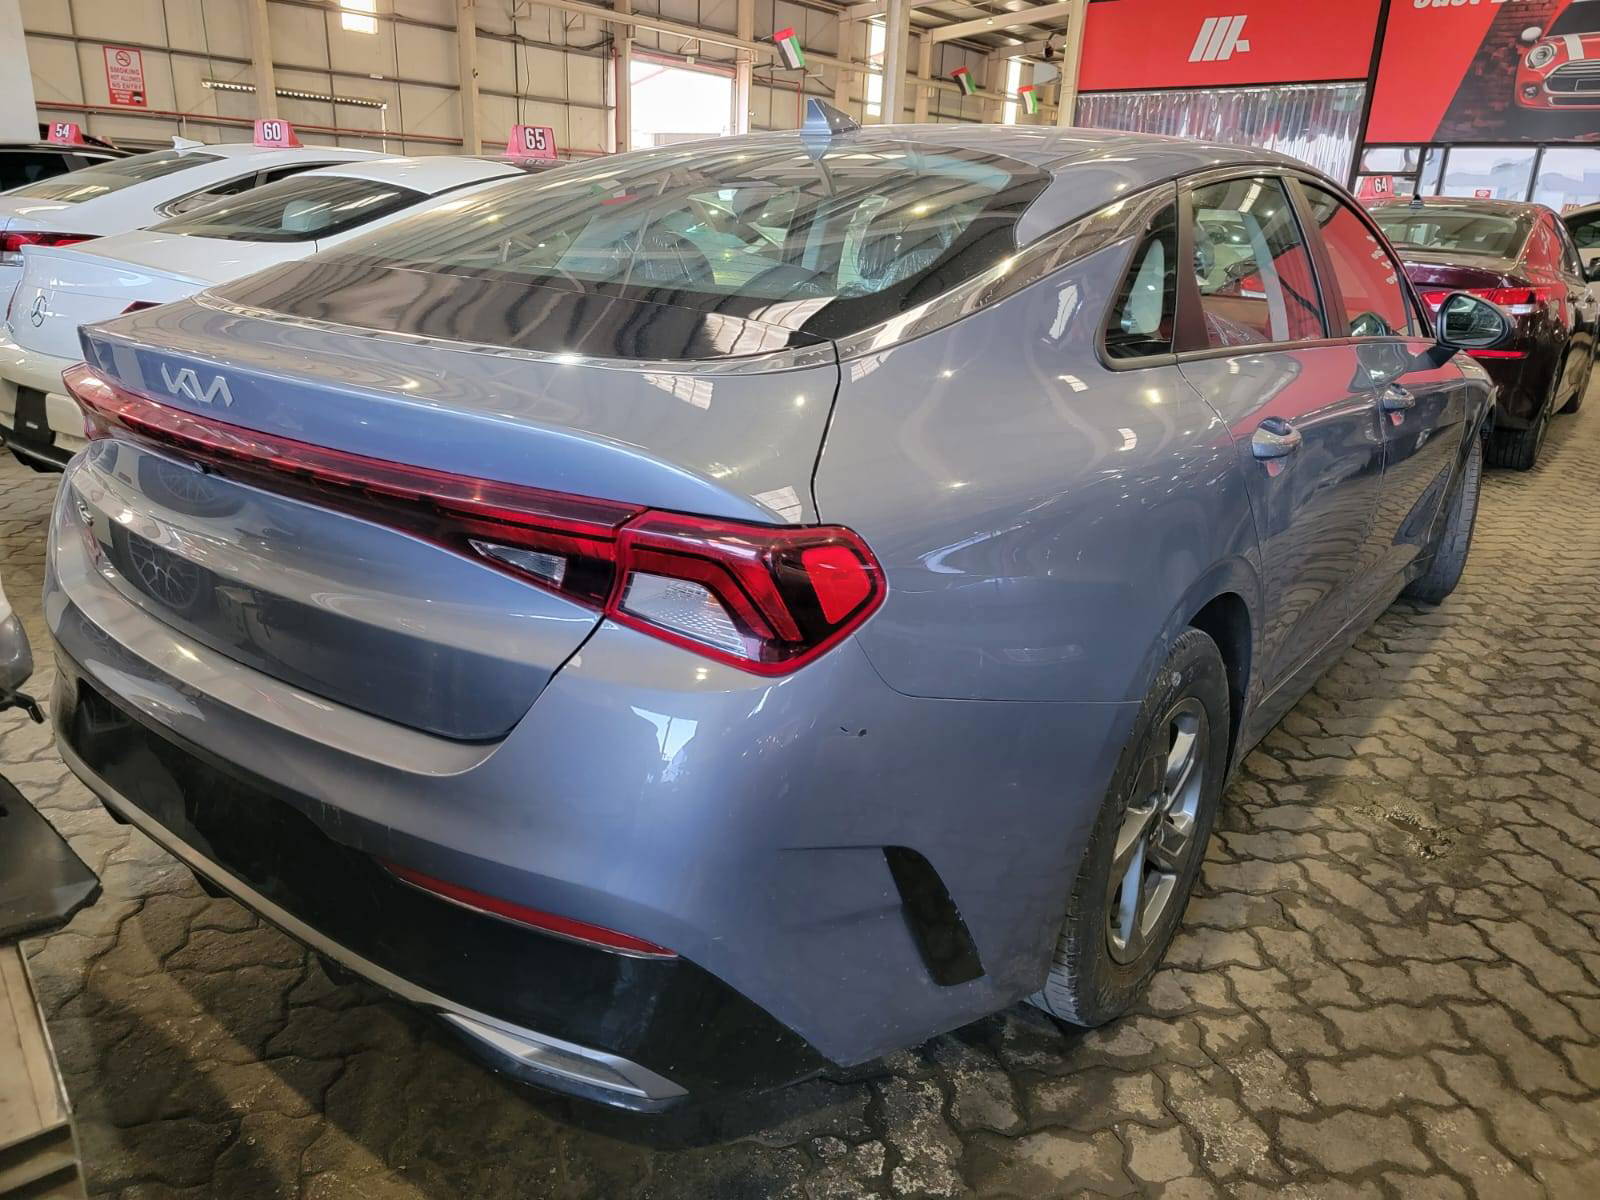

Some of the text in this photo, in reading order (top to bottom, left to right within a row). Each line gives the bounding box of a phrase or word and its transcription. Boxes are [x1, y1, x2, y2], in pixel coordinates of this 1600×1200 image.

[110, 66, 140, 76] SMOKING
[55, 123, 70, 137] 54
[263, 121, 281, 141] 60
[525, 127, 546, 150] 65
[1374, 177, 1388, 193] 64
[161, 361, 233, 408] KIA
